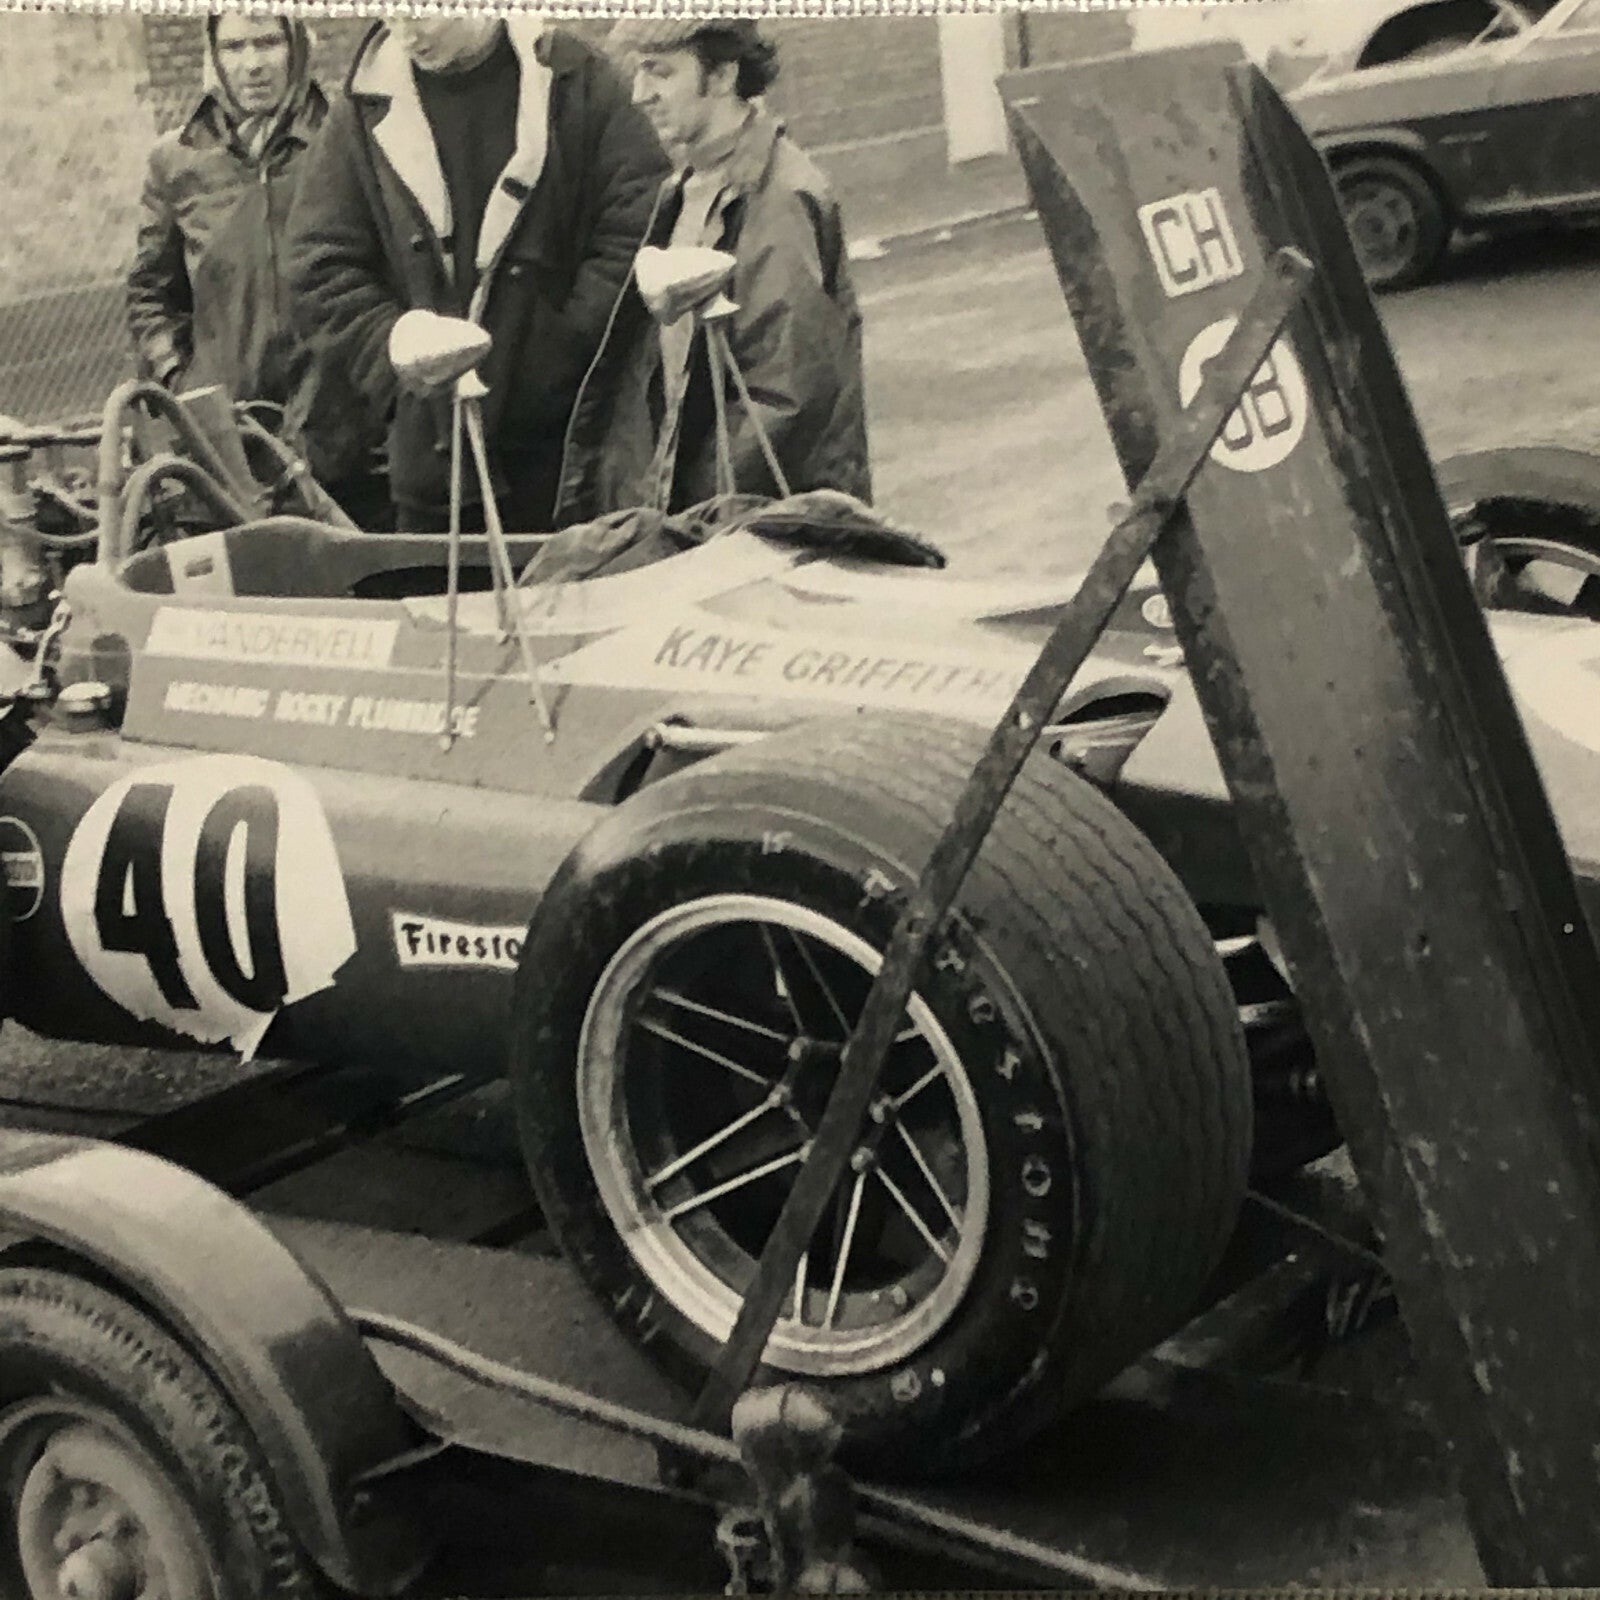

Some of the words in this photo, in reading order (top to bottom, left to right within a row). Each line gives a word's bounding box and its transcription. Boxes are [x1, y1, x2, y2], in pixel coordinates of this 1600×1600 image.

[1151, 195, 1233, 284] CH
[654, 626, 773, 677] KAYE
[95, 783, 289, 1013] 40
